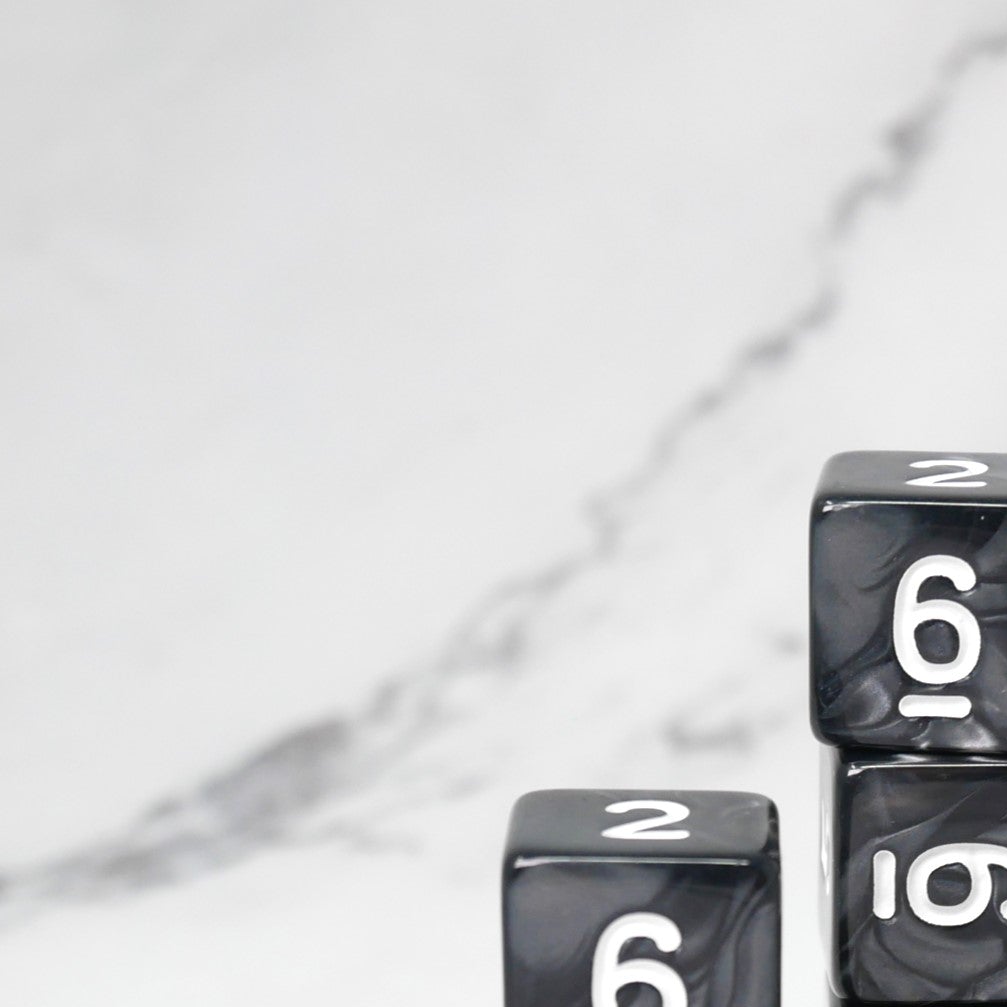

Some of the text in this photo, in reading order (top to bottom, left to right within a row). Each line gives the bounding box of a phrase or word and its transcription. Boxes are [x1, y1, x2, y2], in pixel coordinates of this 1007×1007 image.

[905, 459, 989, 488] 2
[893, 555, 982, 719] 6
[600, 799, 691, 841] 2
